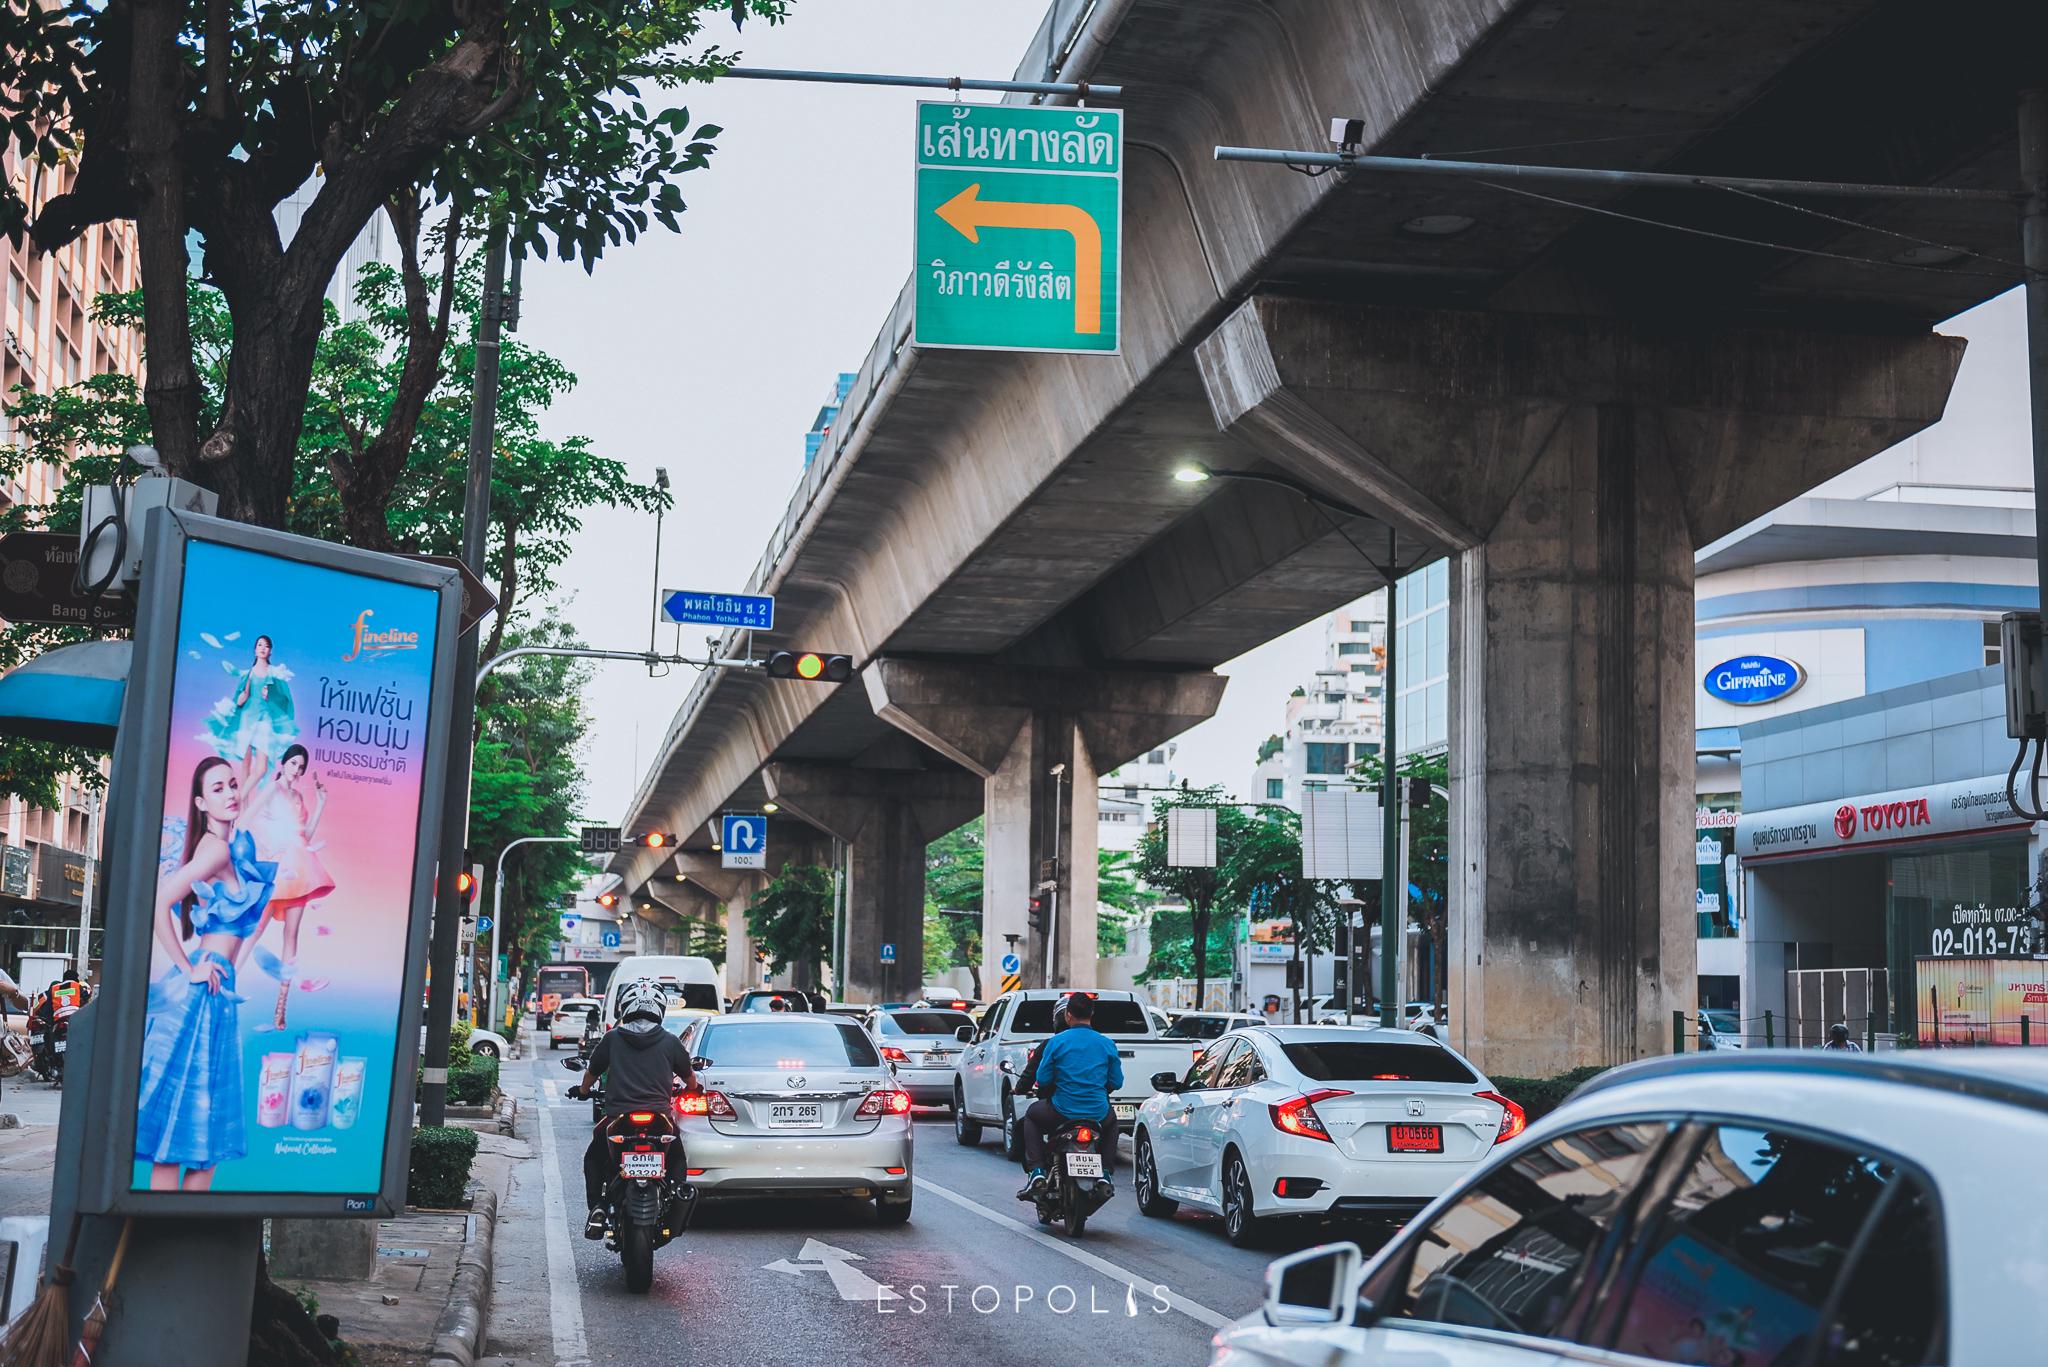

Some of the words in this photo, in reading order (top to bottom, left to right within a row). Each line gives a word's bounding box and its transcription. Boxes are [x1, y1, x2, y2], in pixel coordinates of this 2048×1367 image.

[923, 107, 1114, 165] เส้นทางลัด
[931, 258, 1071, 300] วิภาวดีรังสิต
[52, 604, 87, 619] Bang
[94, 606, 116, 618] Su
[683, 612, 711, 621] Phahon
[715, 615, 739, 623] Yothin
[684, 596, 741, 614] พหลโยธิน
[759, 604, 767, 615] 2
[342, 609, 418, 662] fineline
[319, 676, 413, 721] ให้แฟชั่น
[317, 716, 410, 756] หอมนุ่ม
[315, 748, 407, 773] แบบธรรมชาติ
[1860, 798, 1931, 832] TOYOTA
[1752, 824, 1817, 850] ศูนย์บริการมาตรฐาน
[1952, 903, 1991, 929] เปิดทุกวัน
[1994, 908, 2028, 923] 07.00-1
[667, 998, 679, 1006] AXI
[798, 1106, 817, 1116] 265
[346, 1199, 366, 1210] Plan
